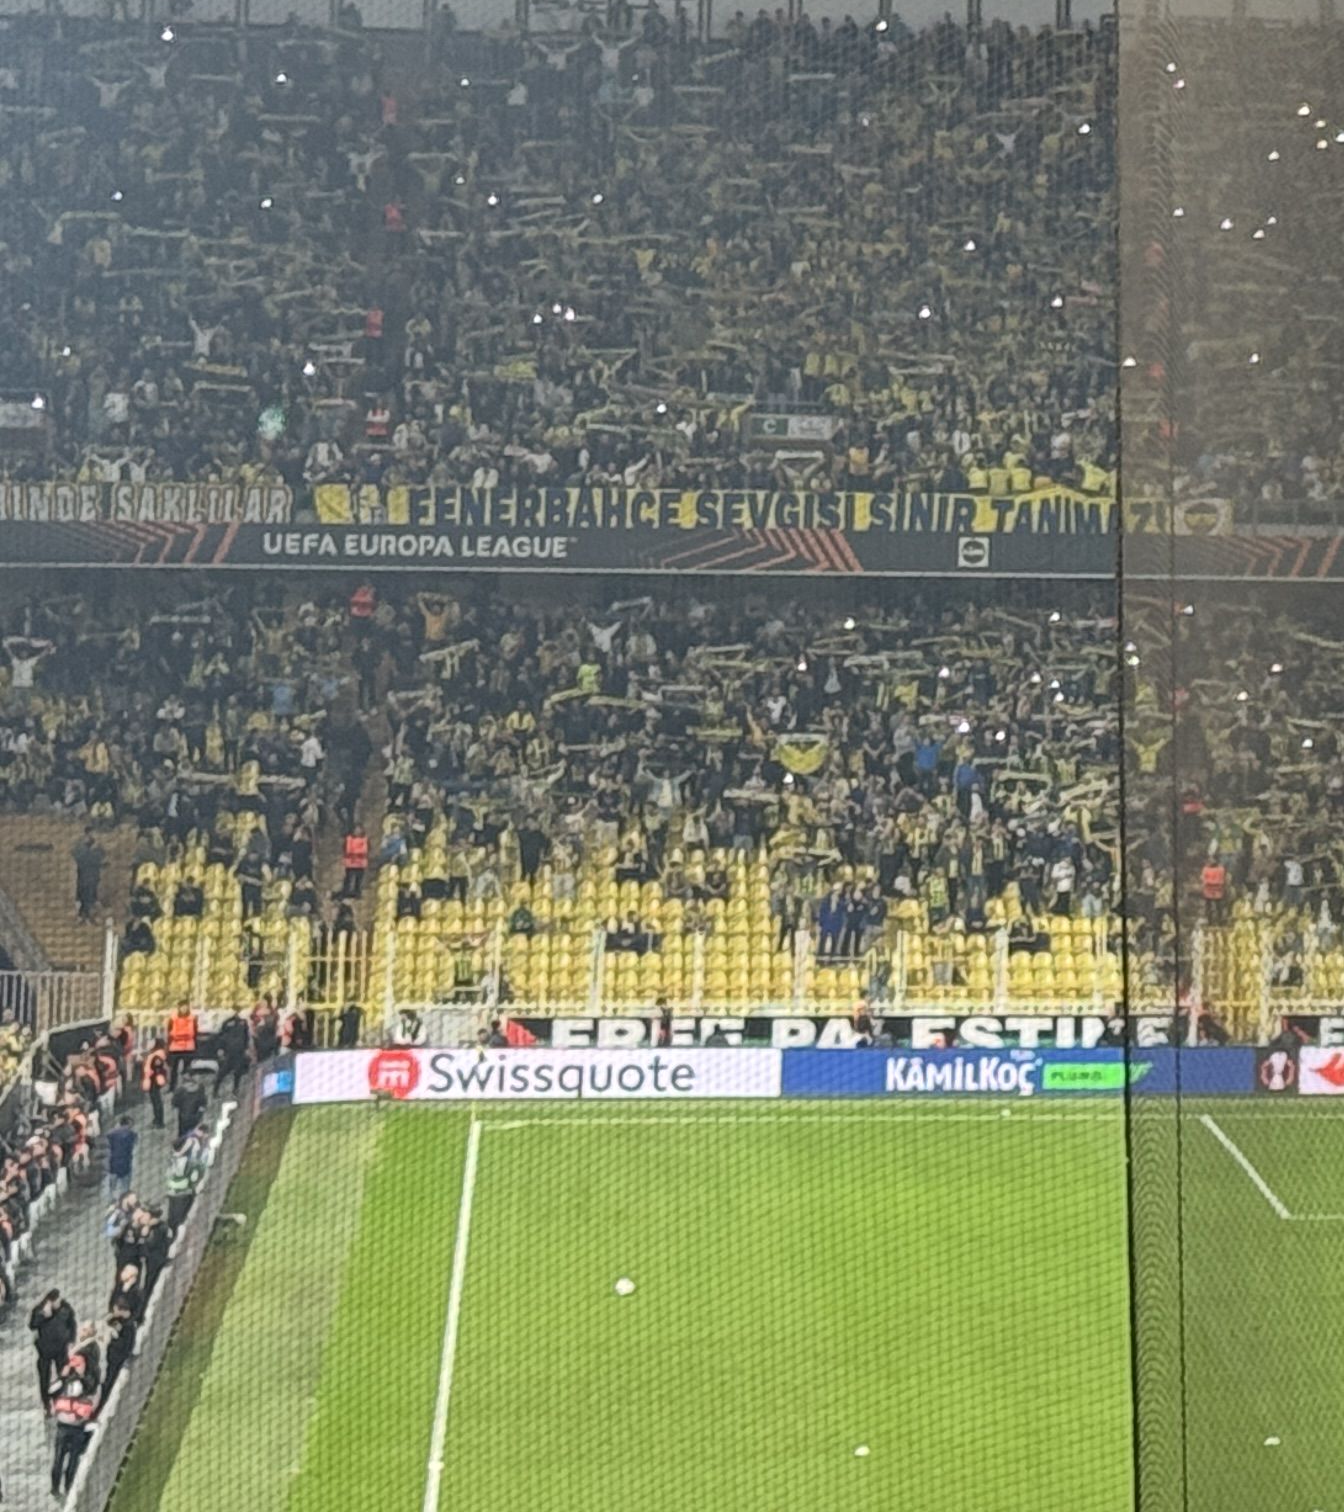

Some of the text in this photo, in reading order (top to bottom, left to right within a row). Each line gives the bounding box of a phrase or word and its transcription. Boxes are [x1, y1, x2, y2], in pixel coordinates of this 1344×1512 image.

[263, 532, 569, 559] UEFA EUROPA LEAGUE
[427, 1051, 696, 1099] Swissquote
